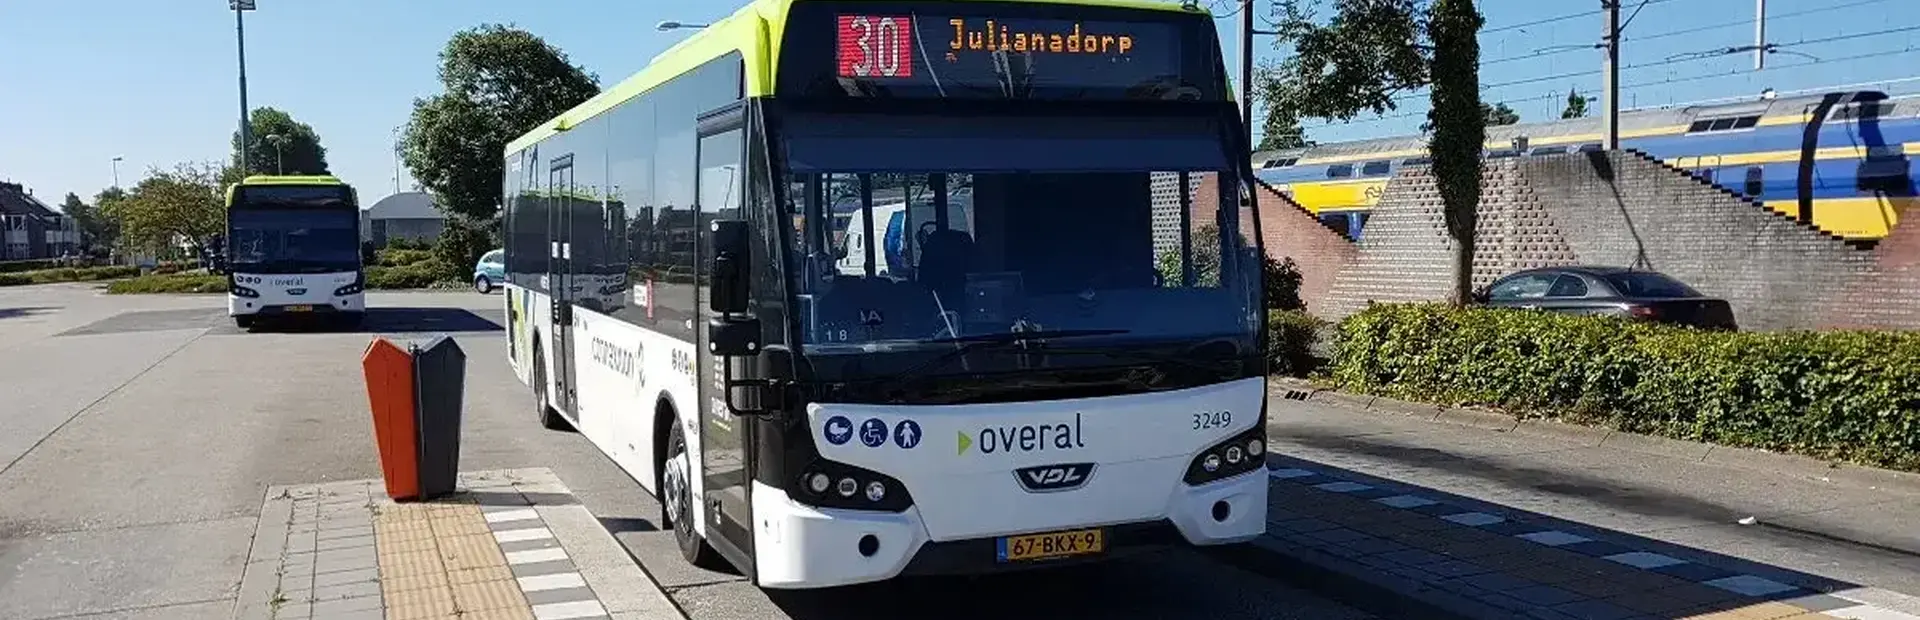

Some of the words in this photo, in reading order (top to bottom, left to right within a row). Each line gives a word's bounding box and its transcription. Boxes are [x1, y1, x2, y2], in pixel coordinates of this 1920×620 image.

[850, 15, 899, 78] 30
[948, 18, 1133, 54] Julianadorp
[979, 412, 1085, 453] overal
[1191, 411, 1232, 430] 3249
[1026, 466, 1082, 485] VDL
[1012, 532, 1096, 556] 67-BKX-9
